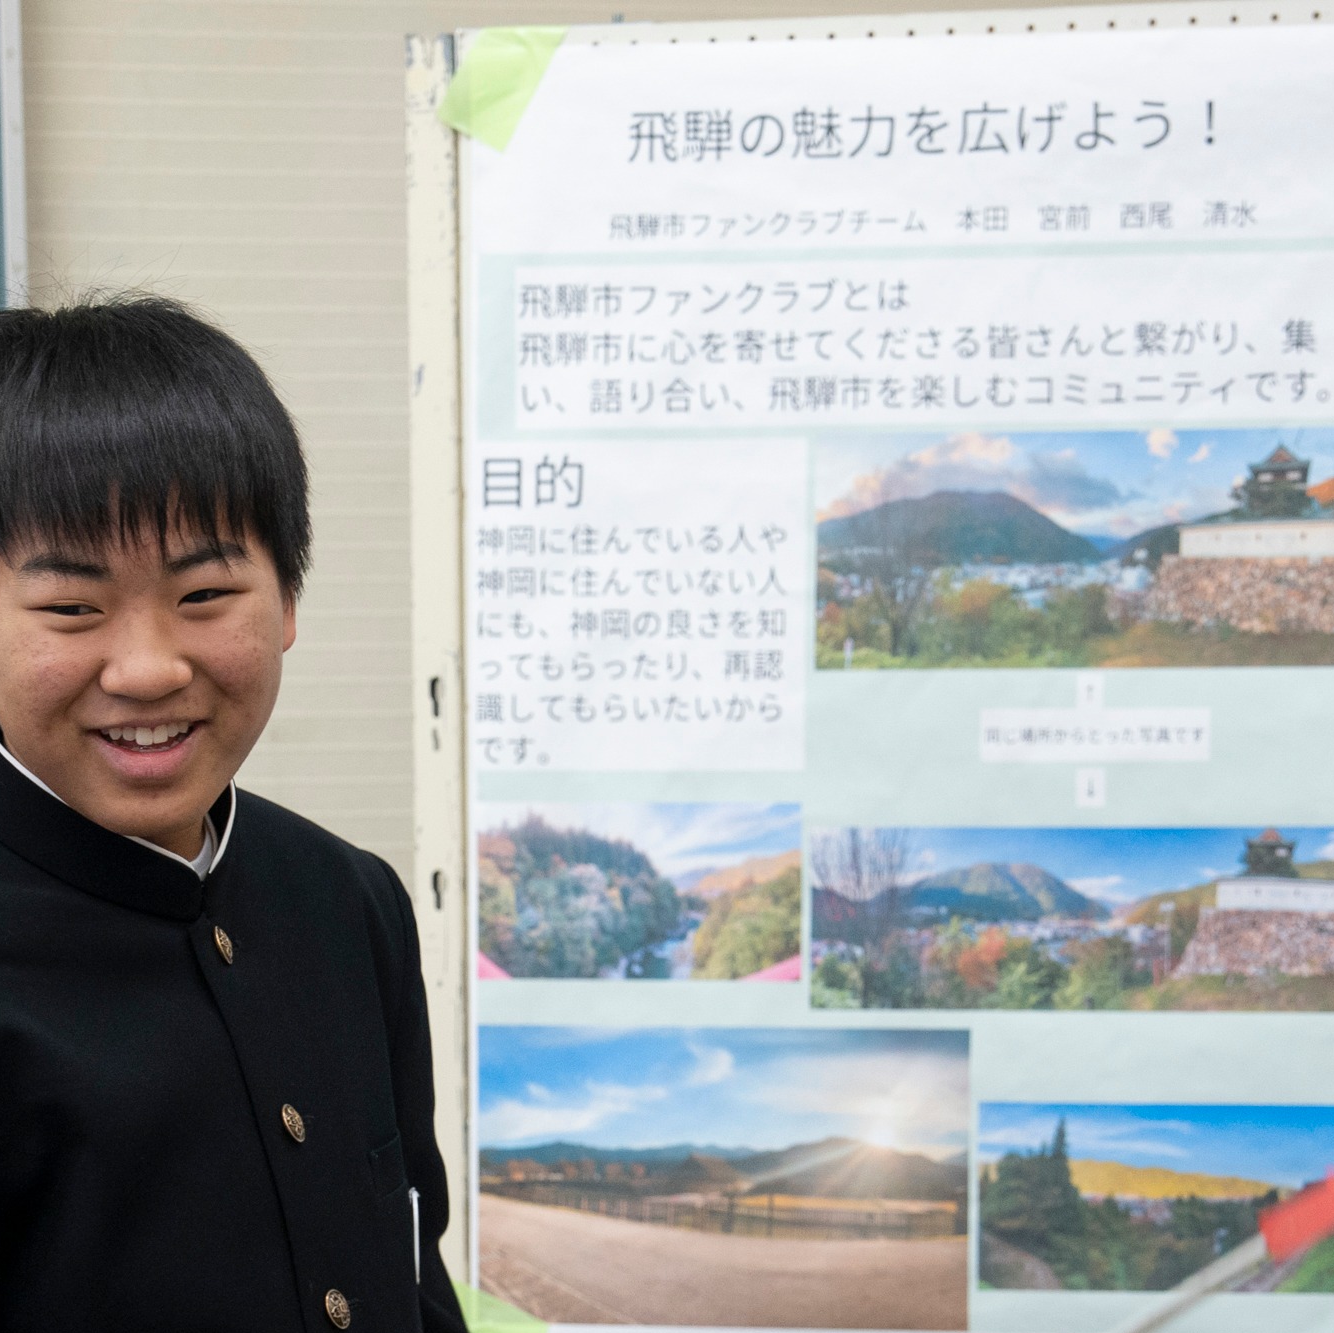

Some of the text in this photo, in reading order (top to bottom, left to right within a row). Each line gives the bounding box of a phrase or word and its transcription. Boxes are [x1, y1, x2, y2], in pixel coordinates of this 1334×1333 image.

[628, 100, 1216, 163] 飛騨の魅力を広げよう！
[609, 201, 1257, 241] 飛騨市ファンクラブチーム 本田 宮前 西尾 清水
[518, 279, 910, 318] 飛騨市ファンクラブとは
[518, 318, 1317, 367] 飛騨市に心を寄せてくださる皆さんと繋がり、集
[520, 370, 1332, 414] い、語り合い、飛騨市を楽しむコミュニティです。
[483, 455, 584, 508] 目的
[476, 525, 788, 557] 神岡に住んでいる人や
[476, 566, 788, 598] 神岡に住んでいない人
[476, 608, 787, 640] にも、神岡の良さを知
[478, 650, 785, 682] ってもらったり、再認
[476, 693, 784, 723] 識してもらいたいから
[476, 735, 551, 766] です。
